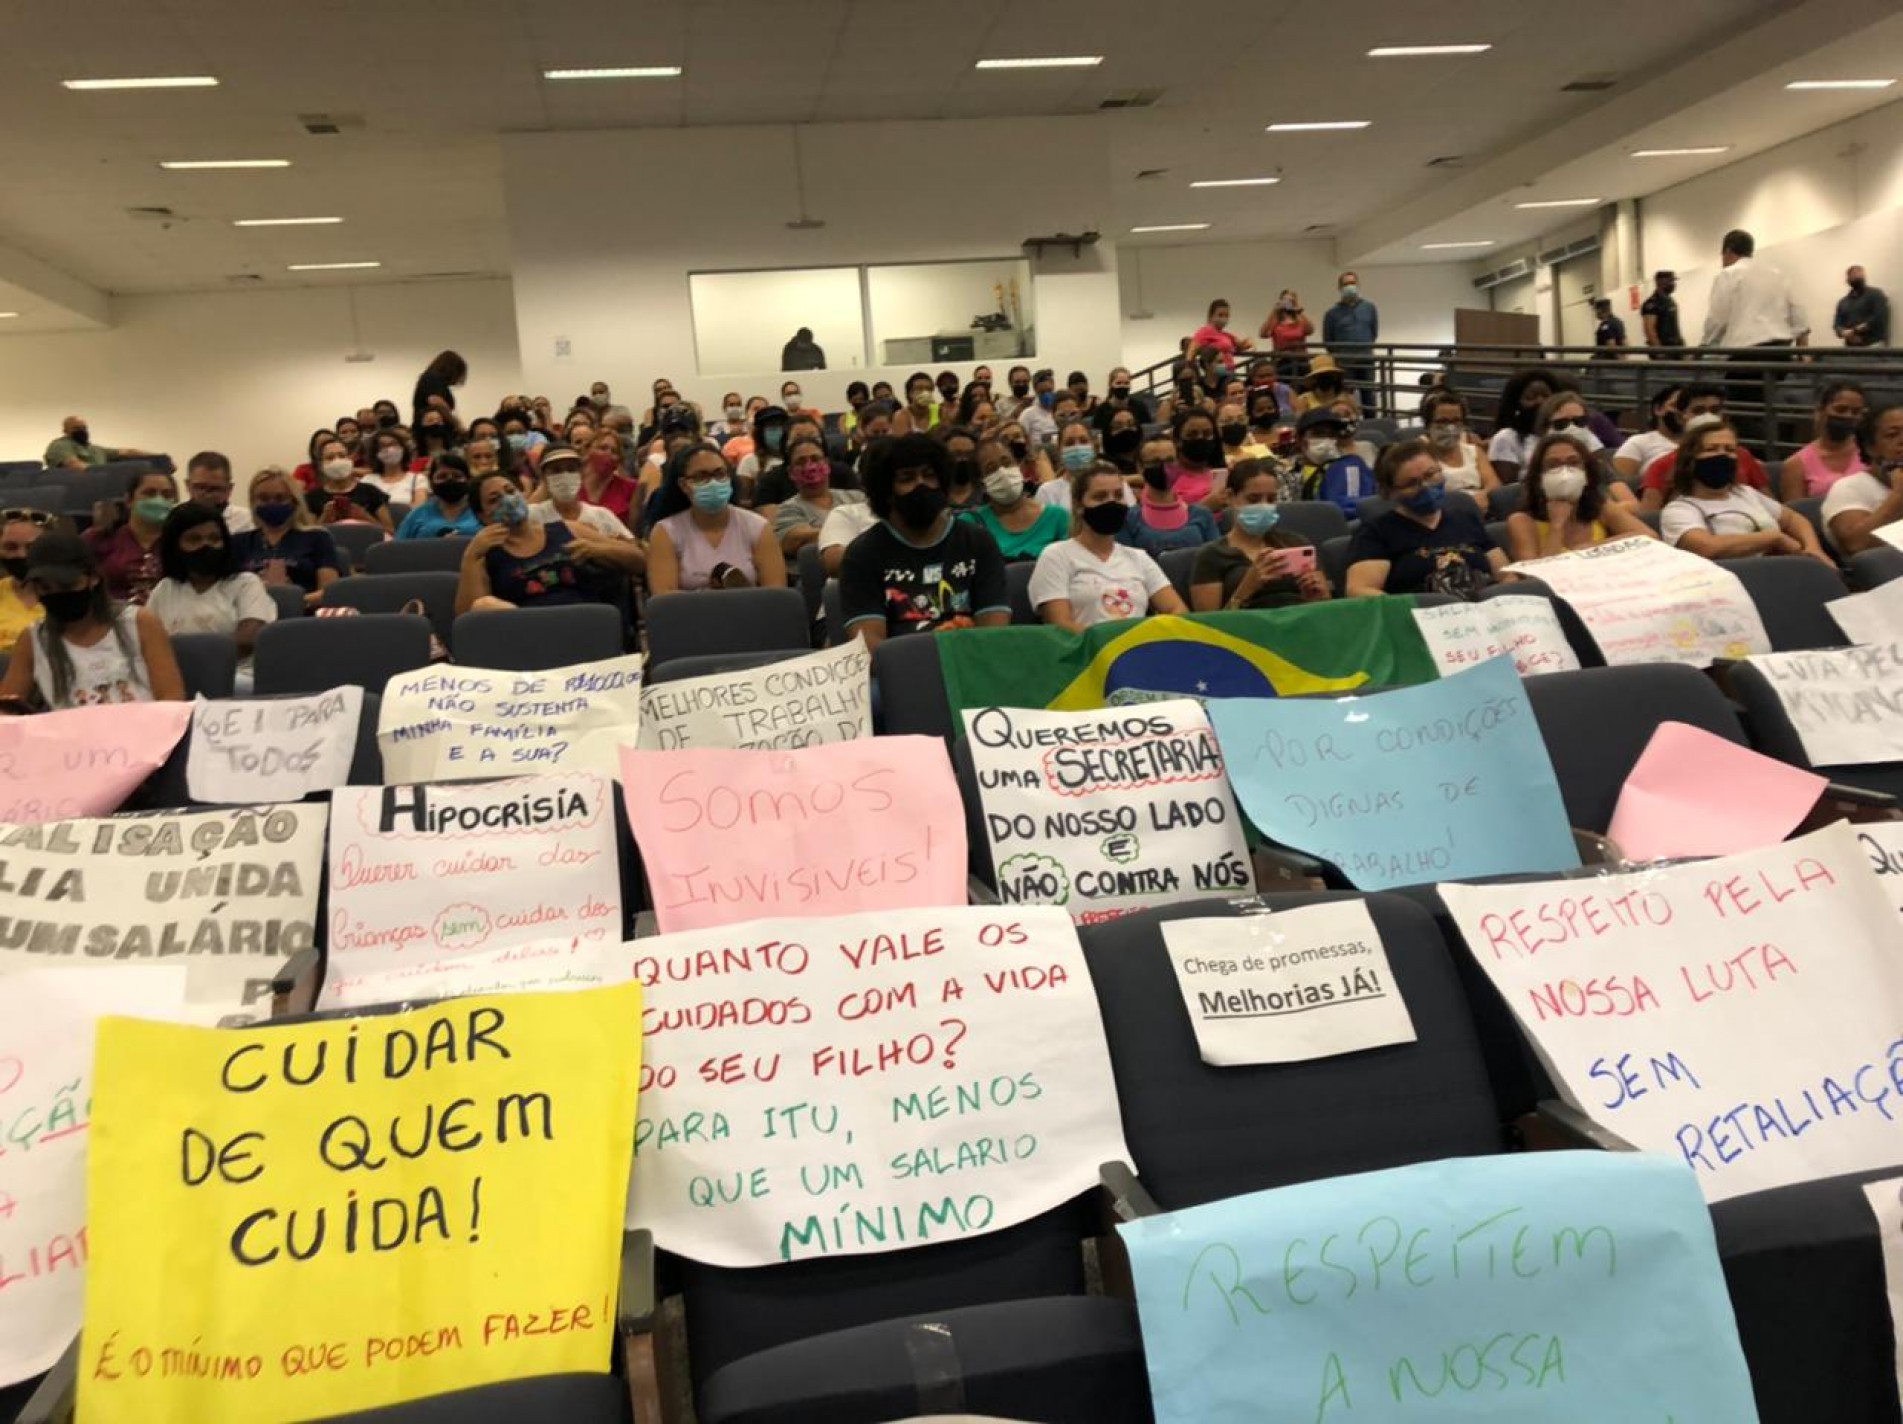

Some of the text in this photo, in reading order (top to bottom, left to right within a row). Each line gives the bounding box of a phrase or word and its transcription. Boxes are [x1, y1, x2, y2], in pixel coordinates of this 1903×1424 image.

[1445, 650, 1480, 664] SEU
[400, 675, 492, 697] MENOS
[512, 679, 546, 696] DE
[428, 694, 590, 717] NÃO SUSTENTA
[639, 681, 758, 727] MELHORES
[287, 693, 346, 731] PARA
[392, 719, 557, 743] MINHA FAMÍLIA
[659, 724, 691, 750] DE
[972, 706, 1174, 750] QUEREMOS
[1255, 696, 1519, 770] POR CONDIÇÕES
[210, 738, 325, 777] TODOS
[449, 741, 569, 763] E A SUA?
[979, 733, 1221, 790] UMA SECRETARIA
[988, 797, 1226, 844] DO NOSSO LADO
[1284, 776, 1479, 828] DIGNAS DE
[331, 842, 602, 892] Querer cuidar das
[1108, 838, 1131, 858] E
[145, 861, 304, 903] UNIDA
[1001, 851, 1250, 904] NÃO CONTRA NÓS
[332, 907, 428, 953] Crianças
[440, 919, 486, 941] sem
[496, 905, 570, 930] cuidar
[1480, 857, 1837, 961] RESPEITO PELA
[633, 940, 809, 987] QUANTO
[839, 926, 946, 970] VALE
[978, 922, 1031, 948] OS
[1184, 939, 1373, 977] Chega de promessas,
[641, 963, 1069, 1037] CUIDADOS COM A VIDA
[1198, 967, 1382, 1016] Melhorias JÁ!
[1528, 942, 1799, 1021] NOSSA LUTA
[698, 1053, 780, 1085] SEU
[812, 1018, 967, 1078] FILHO?
[1588, 1051, 1702, 1110] SEM
[180, 1092, 555, 1187] DE QUEM
[633, 1071, 1044, 1157] PARA ITU, MENOS
[689, 1133, 1037, 1208] QUE UM SALARIO
[778, 1193, 995, 1262] MÍNIMO
[1184, 1205, 1618, 1327] RESPEITEM
[94, 1330, 121, 1380] É
[130, 1346, 153, 1377] O
[281, 1340, 348, 1376] QUE
[365, 1324, 463, 1367] PODEM
[482, 1295, 610, 1347] FAZER!
[1315, 1332, 1567, 1424] A NOSSA
